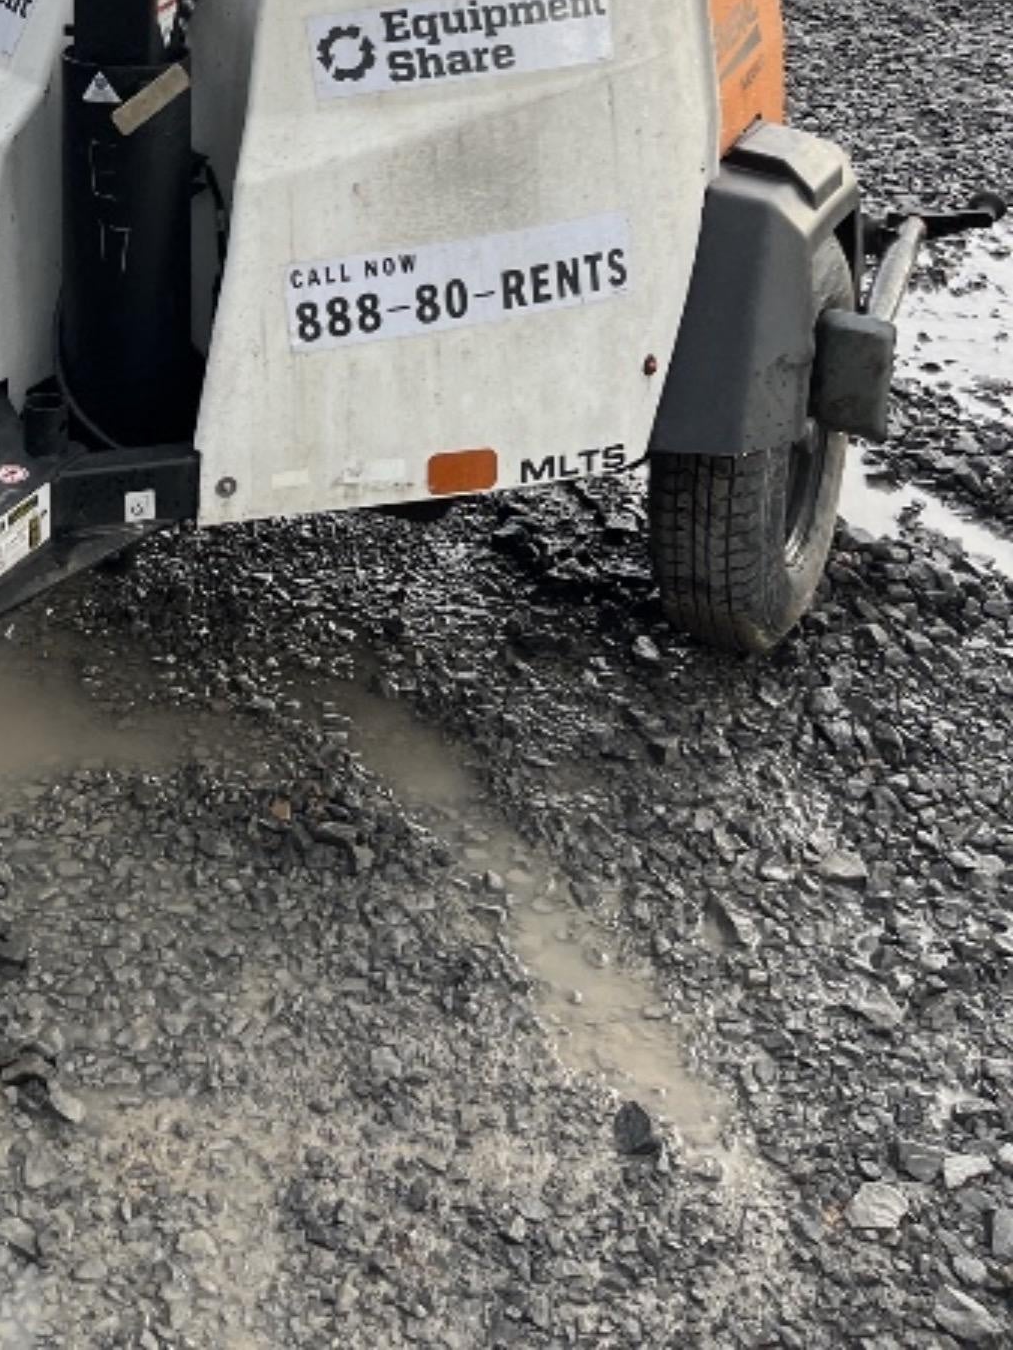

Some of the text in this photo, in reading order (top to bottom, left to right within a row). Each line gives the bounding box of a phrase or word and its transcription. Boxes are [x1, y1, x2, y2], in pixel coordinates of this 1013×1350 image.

[386, 42, 517, 82] Share
[289, 253, 418, 289] CALL NOW
[295, 247, 629, 343] 888-80-RENTS
[520, 443, 626, 484] MLTS
